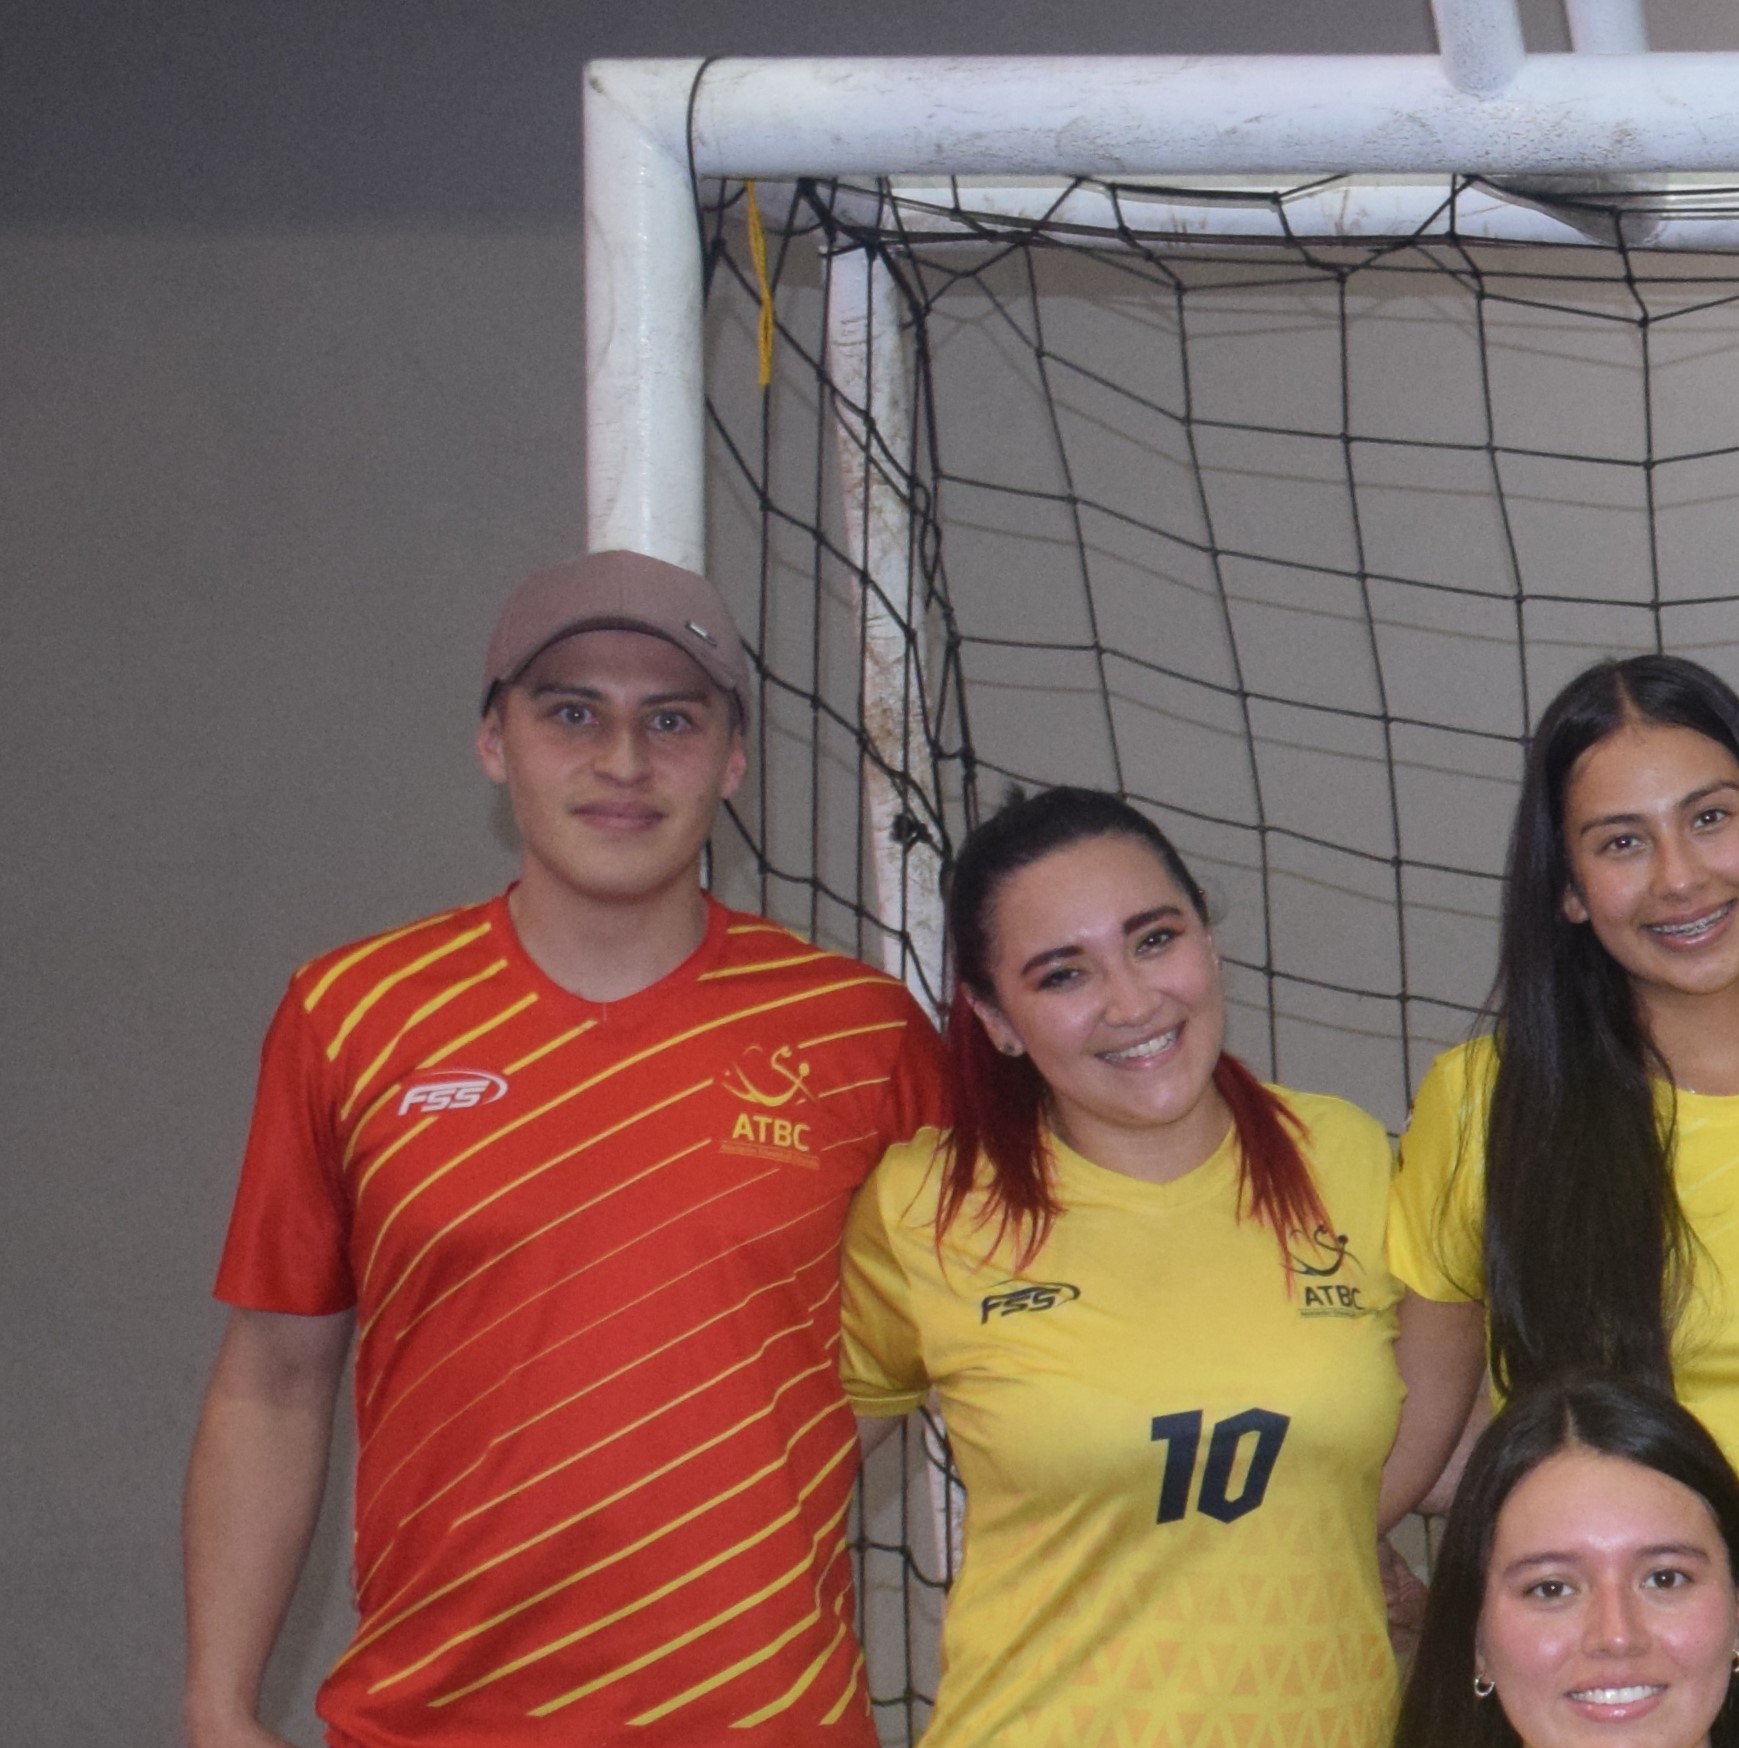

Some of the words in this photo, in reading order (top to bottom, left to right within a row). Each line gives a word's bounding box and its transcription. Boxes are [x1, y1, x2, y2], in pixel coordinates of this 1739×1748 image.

[398, 1080, 489, 1116] FSS
[732, 1113, 811, 1152] ATBC
[981, 1286, 1062, 1325] FSS
[1305, 1284, 1365, 1311] ATBC
[1151, 1407, 1291, 1524] 10
